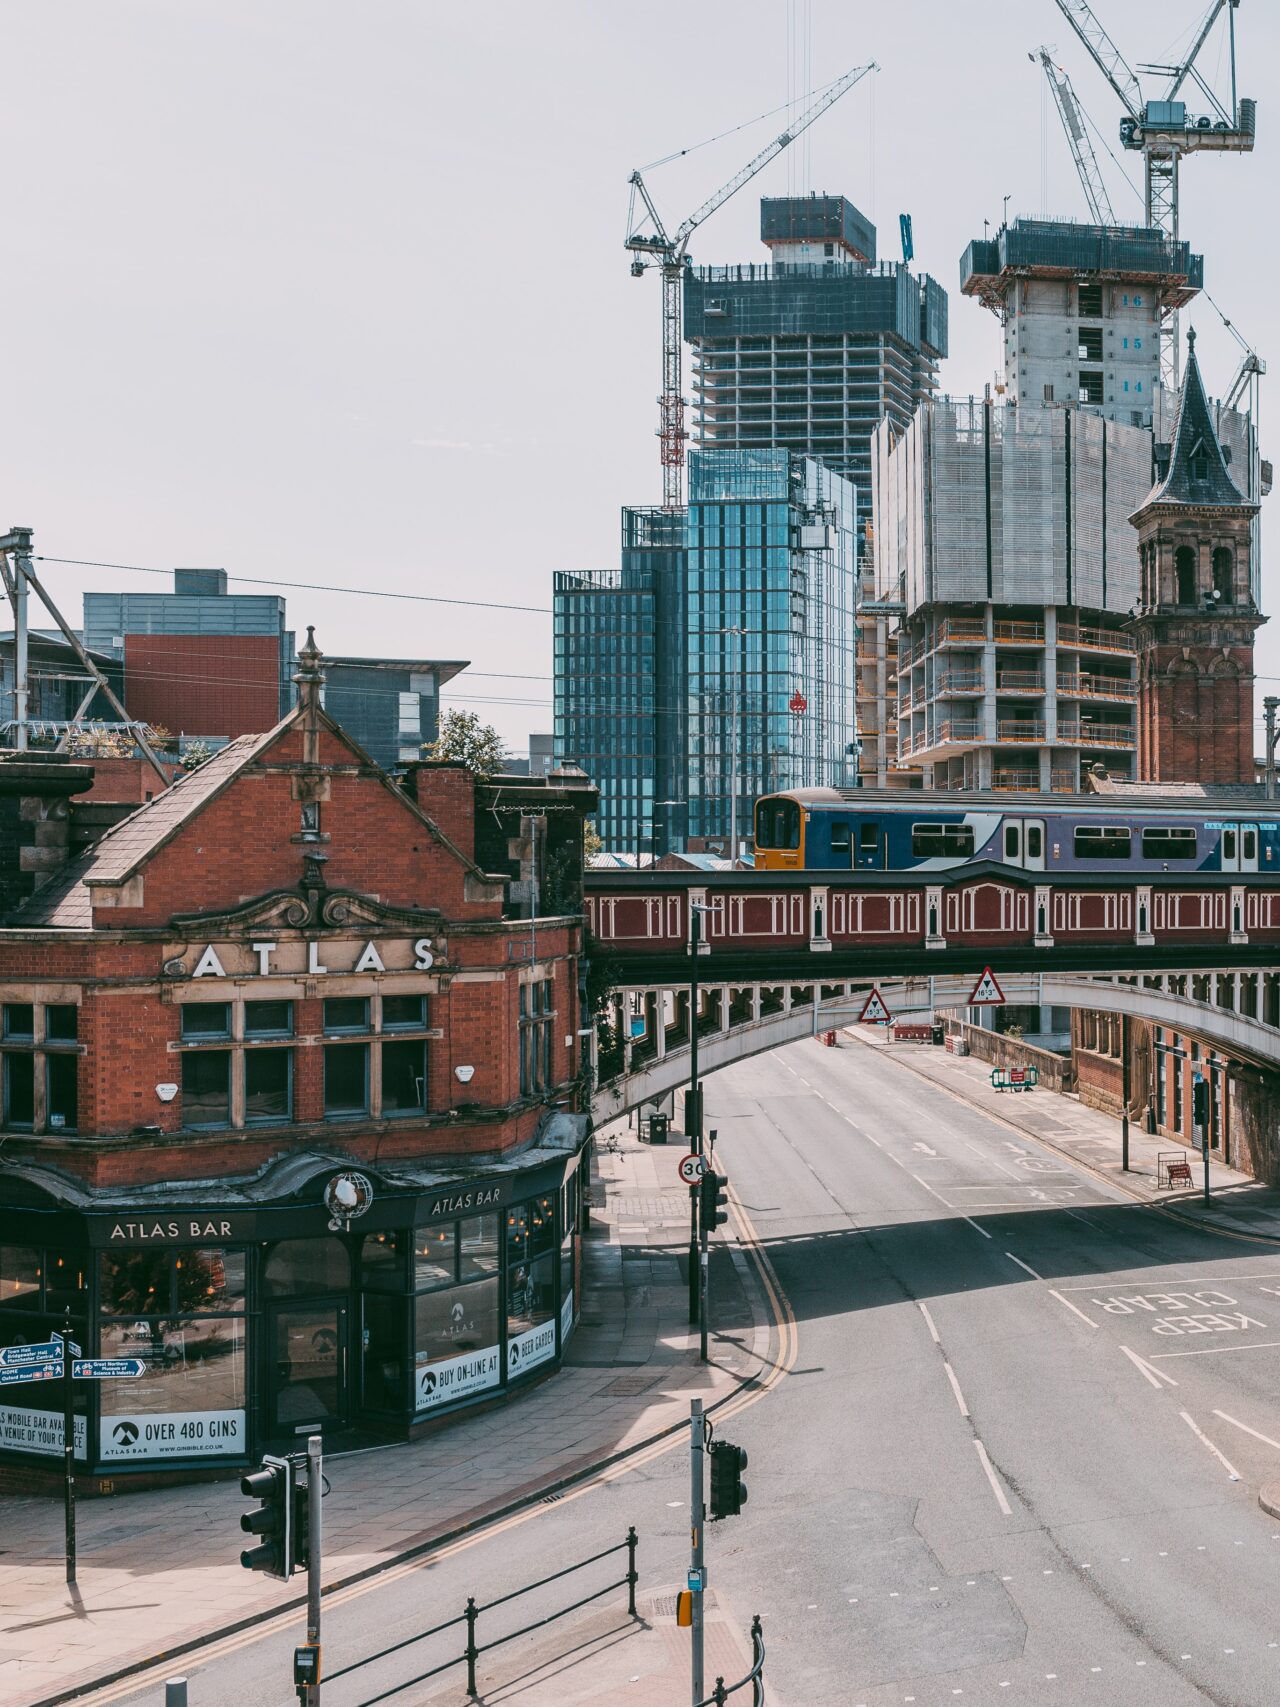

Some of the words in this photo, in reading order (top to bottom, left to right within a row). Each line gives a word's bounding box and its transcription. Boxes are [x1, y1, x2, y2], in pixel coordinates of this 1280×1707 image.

[1123, 294, 1142, 307] 16
[1123, 337, 1142, 350] 15
[1123, 381, 1142, 393] 14
[192, 938, 434, 978] ATLAS
[431, 1196, 472, 1216] ATLAS
[476, 1187, 501, 1207] BAR
[110, 1222, 179, 1239] ATLAS
[190, 1221, 232, 1237] BAR
[1092, 1291, 1238, 1314] CLEAR
[441, 1320, 475, 1337] ATLAS
[1152, 1312, 1268, 1335] KEEP
[521, 1338, 534, 1358] BEER
[535, 1328, 554, 1351] GARDEN
[439, 1368, 455, 1387] BUY
[457, 1358, 487, 1382] ON-LINE
[488, 1355, 498, 1372] AT
[7, 1412, 32, 1427] MOBILE
[33, 1416, 47, 1429] BAR
[145, 1423, 175, 1441] OVER
[180, 1422, 204, 1439] 480
[209, 1419, 237, 1437] GINS
[4, 1426, 26, 1441] VENUE
[27, 1429, 36, 1442] OF
[37, 1431, 56, 1445] YOUR
[58, 1434, 83, 1449] CHCE
